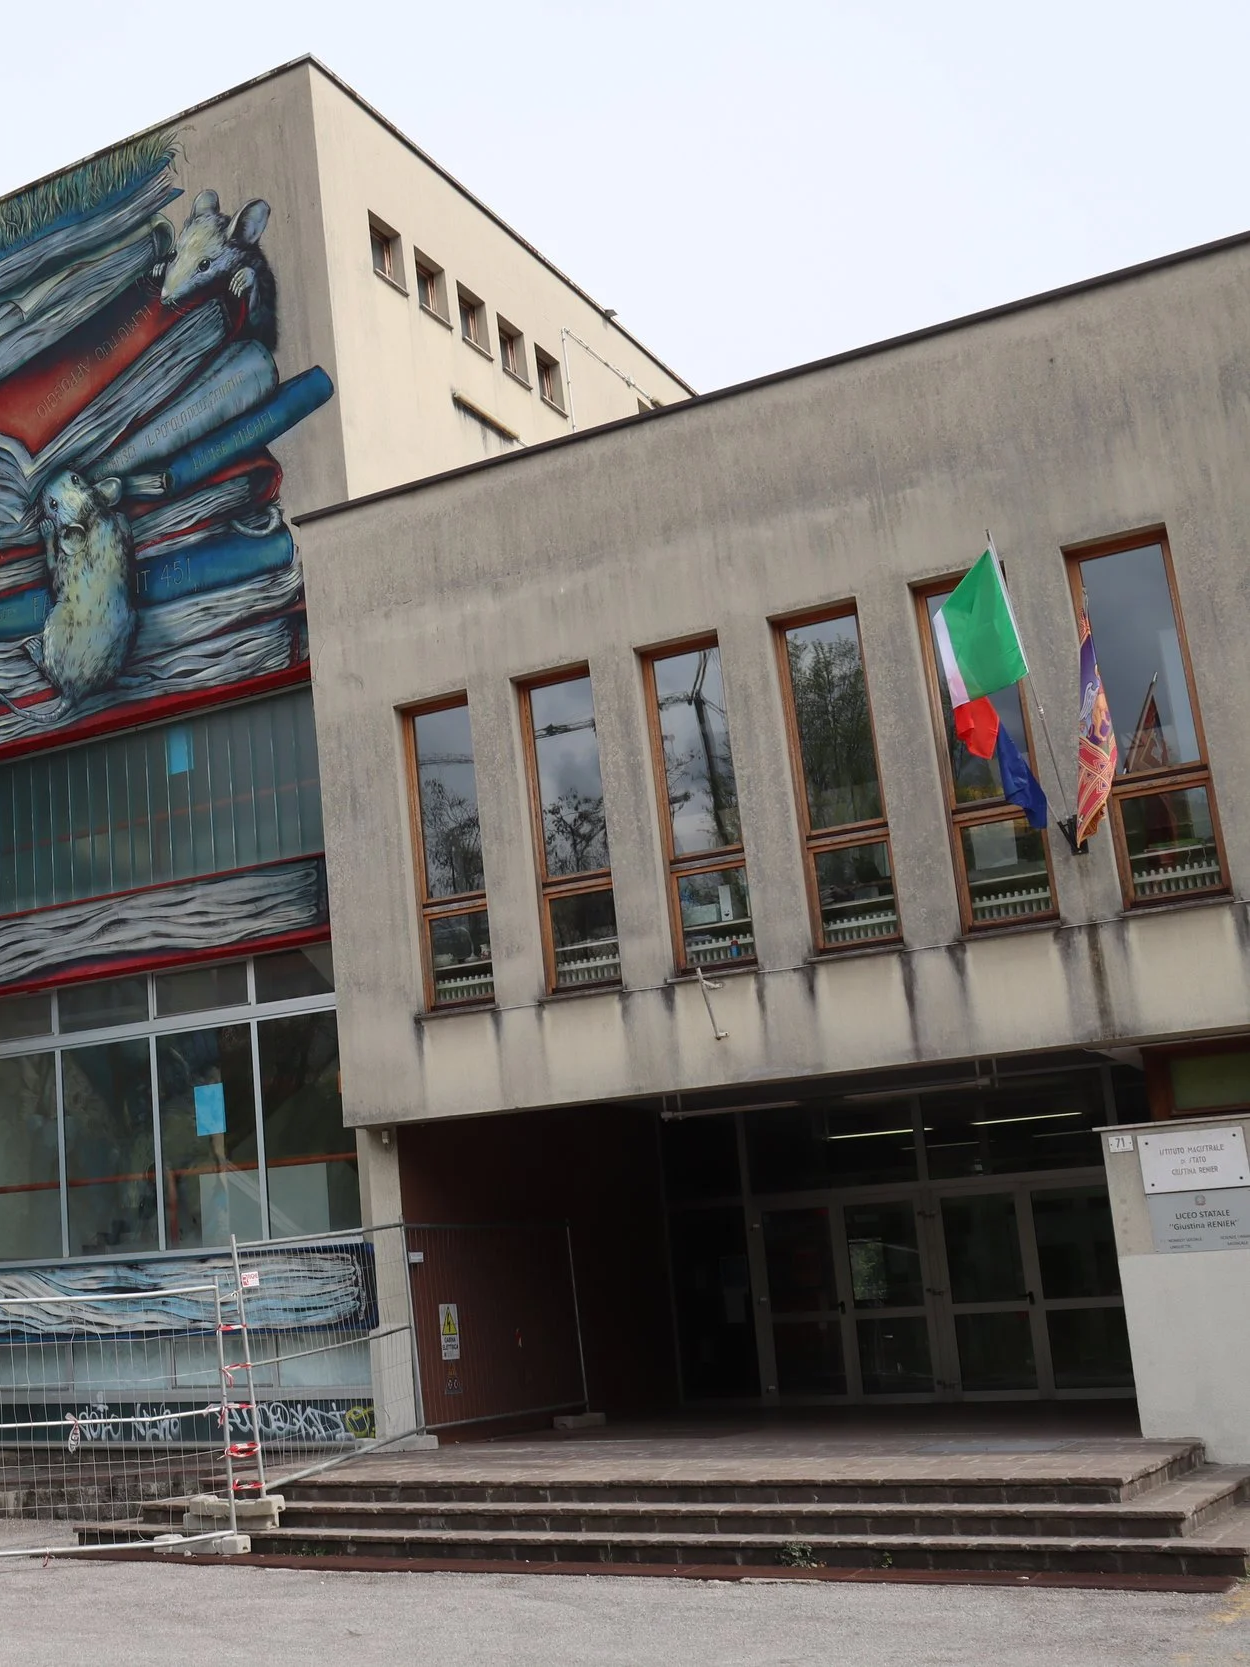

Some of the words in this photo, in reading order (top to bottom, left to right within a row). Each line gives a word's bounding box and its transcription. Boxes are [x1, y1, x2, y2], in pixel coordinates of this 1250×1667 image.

[160, 556, 191, 588] 451
[1115, 1137, 1126, 1148] 71
[1159, 1146, 1186, 1156] ISTITUTO
[1187, 1144, 1225, 1154] MAGISTRALE
[1188, 1156, 1207, 1164] STATO
[1171, 1167, 1197, 1176] GIUSTINA
[1198, 1165, 1219, 1174] RENIER
[1175, 1211, 1198, 1220] LICEO
[1199, 1209, 1231, 1218] STATALE
